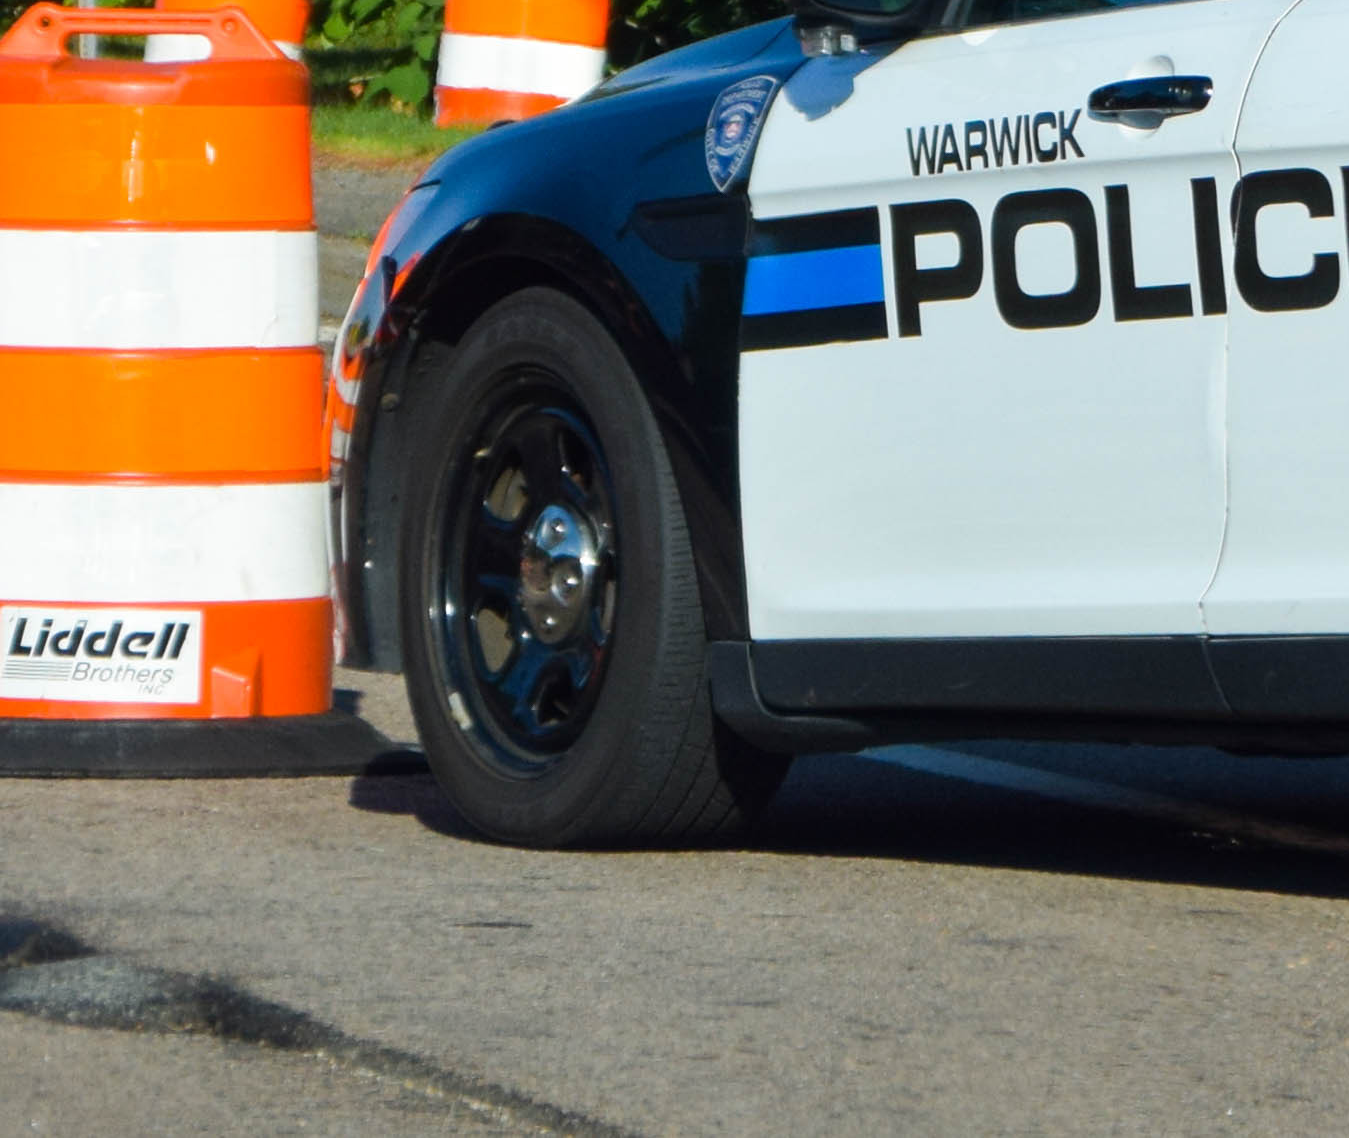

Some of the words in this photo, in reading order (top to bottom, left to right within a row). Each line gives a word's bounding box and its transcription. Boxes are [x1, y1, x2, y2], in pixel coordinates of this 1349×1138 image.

[906, 108, 1085, 175] WARWICK
[8, 618, 191, 659] Liddell
[71, 661, 175, 684] Brothers
